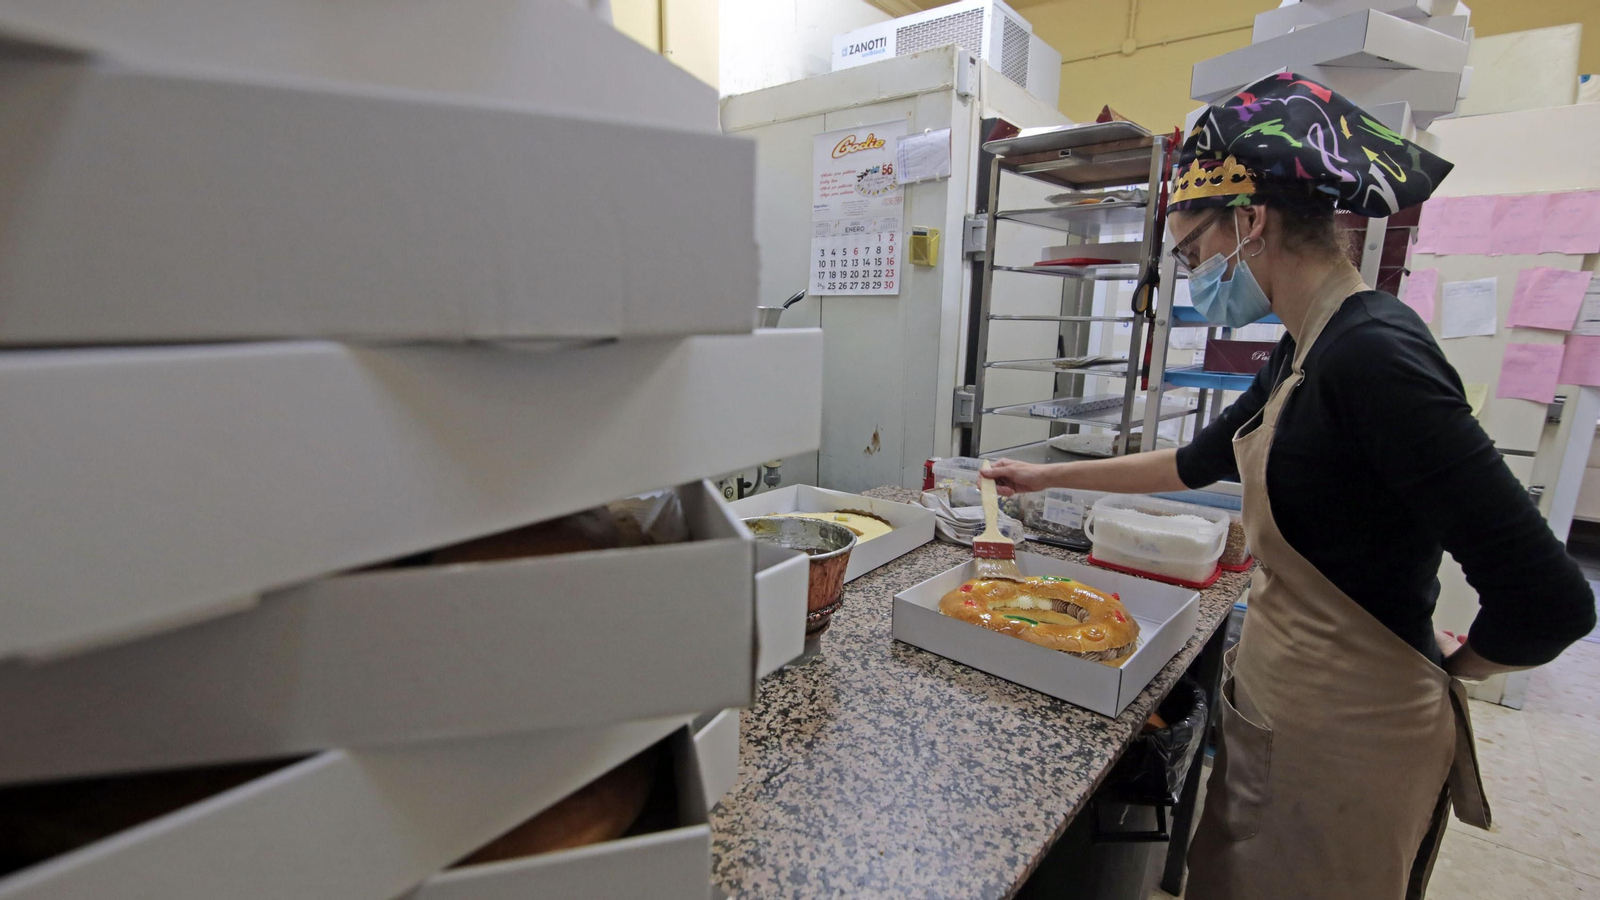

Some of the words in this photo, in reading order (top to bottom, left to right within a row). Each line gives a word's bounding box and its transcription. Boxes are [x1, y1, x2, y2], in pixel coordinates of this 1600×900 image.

[848, 37, 887, 56] ZANOTTI
[861, 48, 886, 58] uniblock
[882, 163, 893, 175] 56
[878, 234, 881, 242] 1
[820, 249, 825, 257] 3
[842, 248, 847, 256] 5
[865, 247, 870, 255] 7
[876, 246, 881, 254] 8
[818, 260, 826, 268] 10
[852, 259, 858, 267] 13
[863, 258, 870, 266] 14
[862, 270, 870, 278] 21
[873, 270, 882, 278] 22
[885, 269, 894, 277] 23
[884, 281, 894, 289] 30
